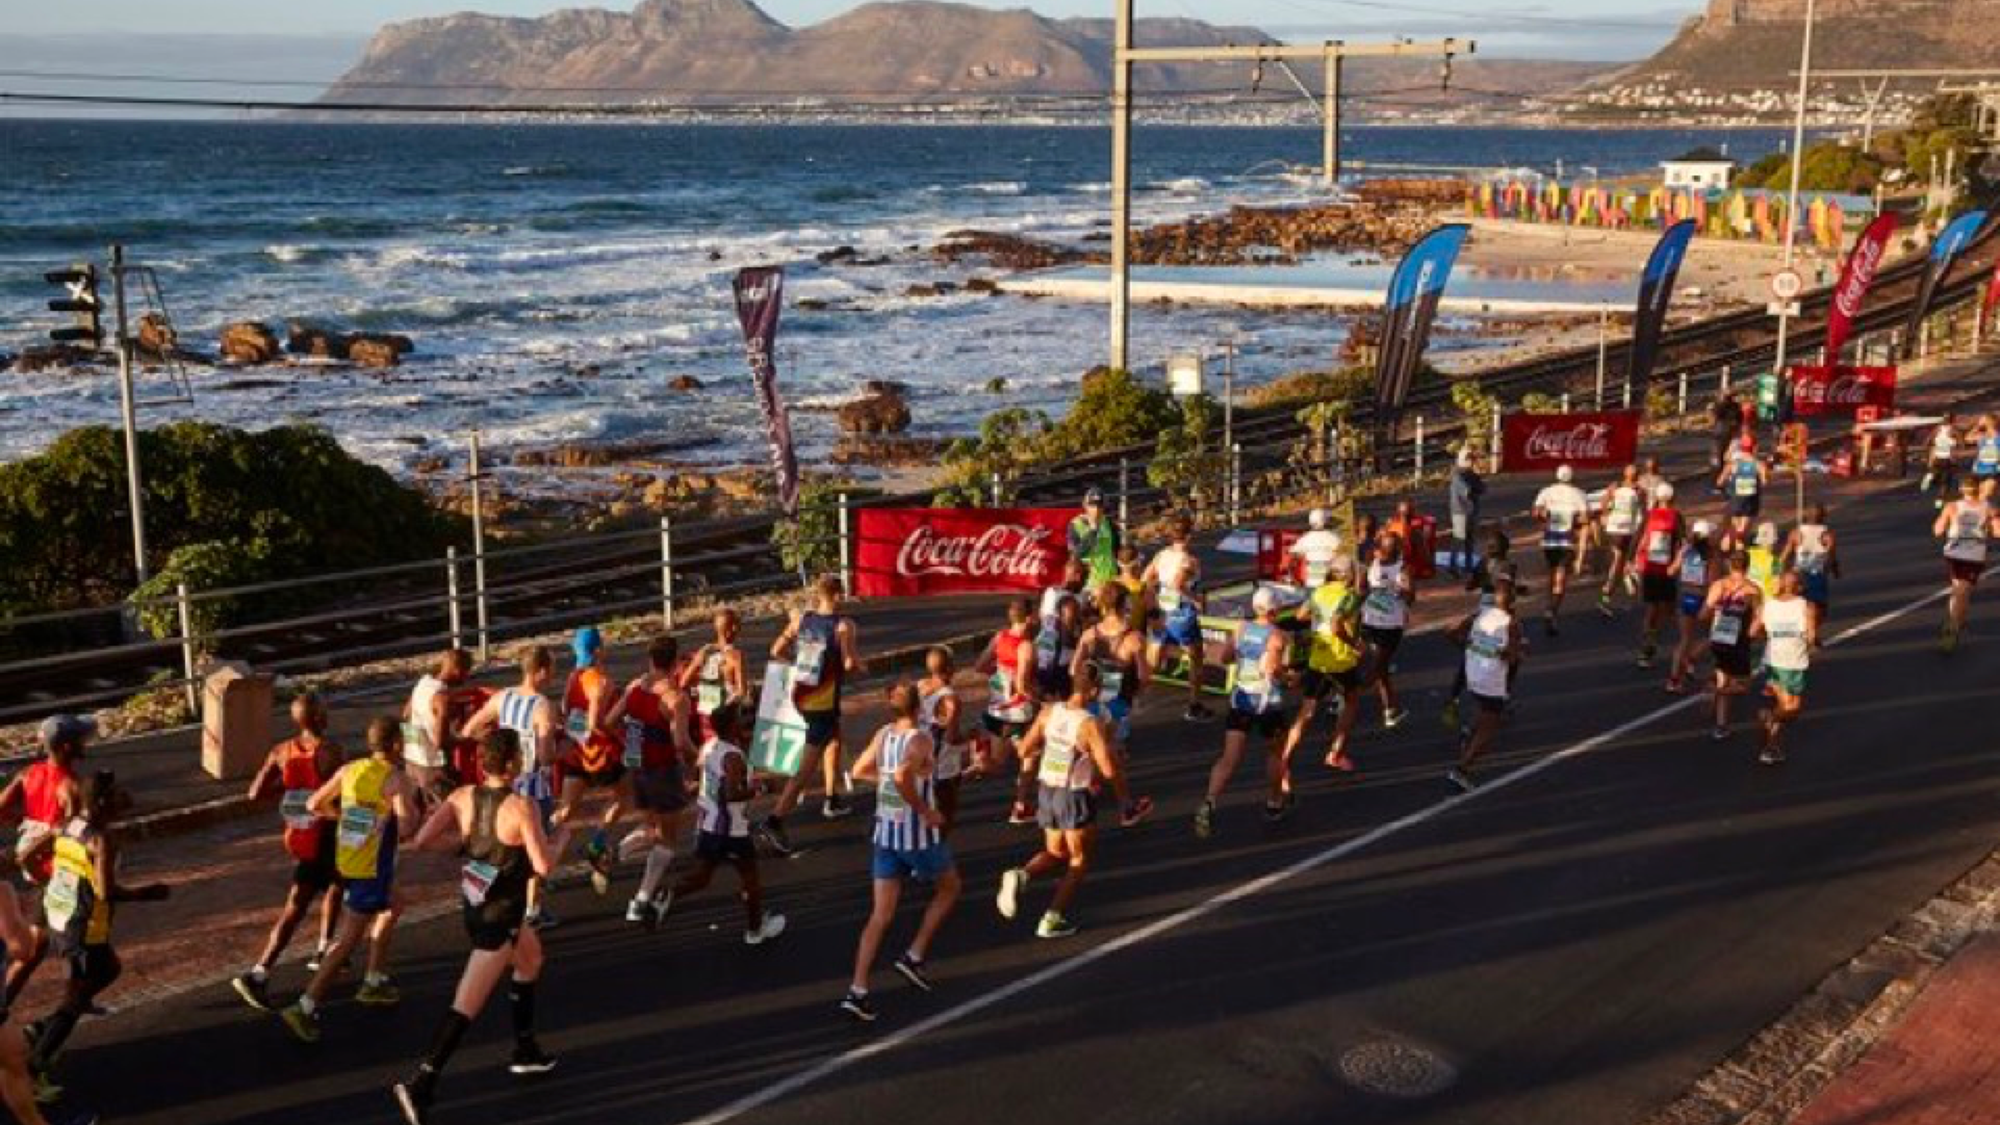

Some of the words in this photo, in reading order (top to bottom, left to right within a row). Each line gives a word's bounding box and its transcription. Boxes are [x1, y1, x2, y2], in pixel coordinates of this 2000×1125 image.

[1524, 422, 1611, 460] Coca-Cola
[896, 524, 1053, 577] Coca-Cola
[760, 724, 806, 771] 17
